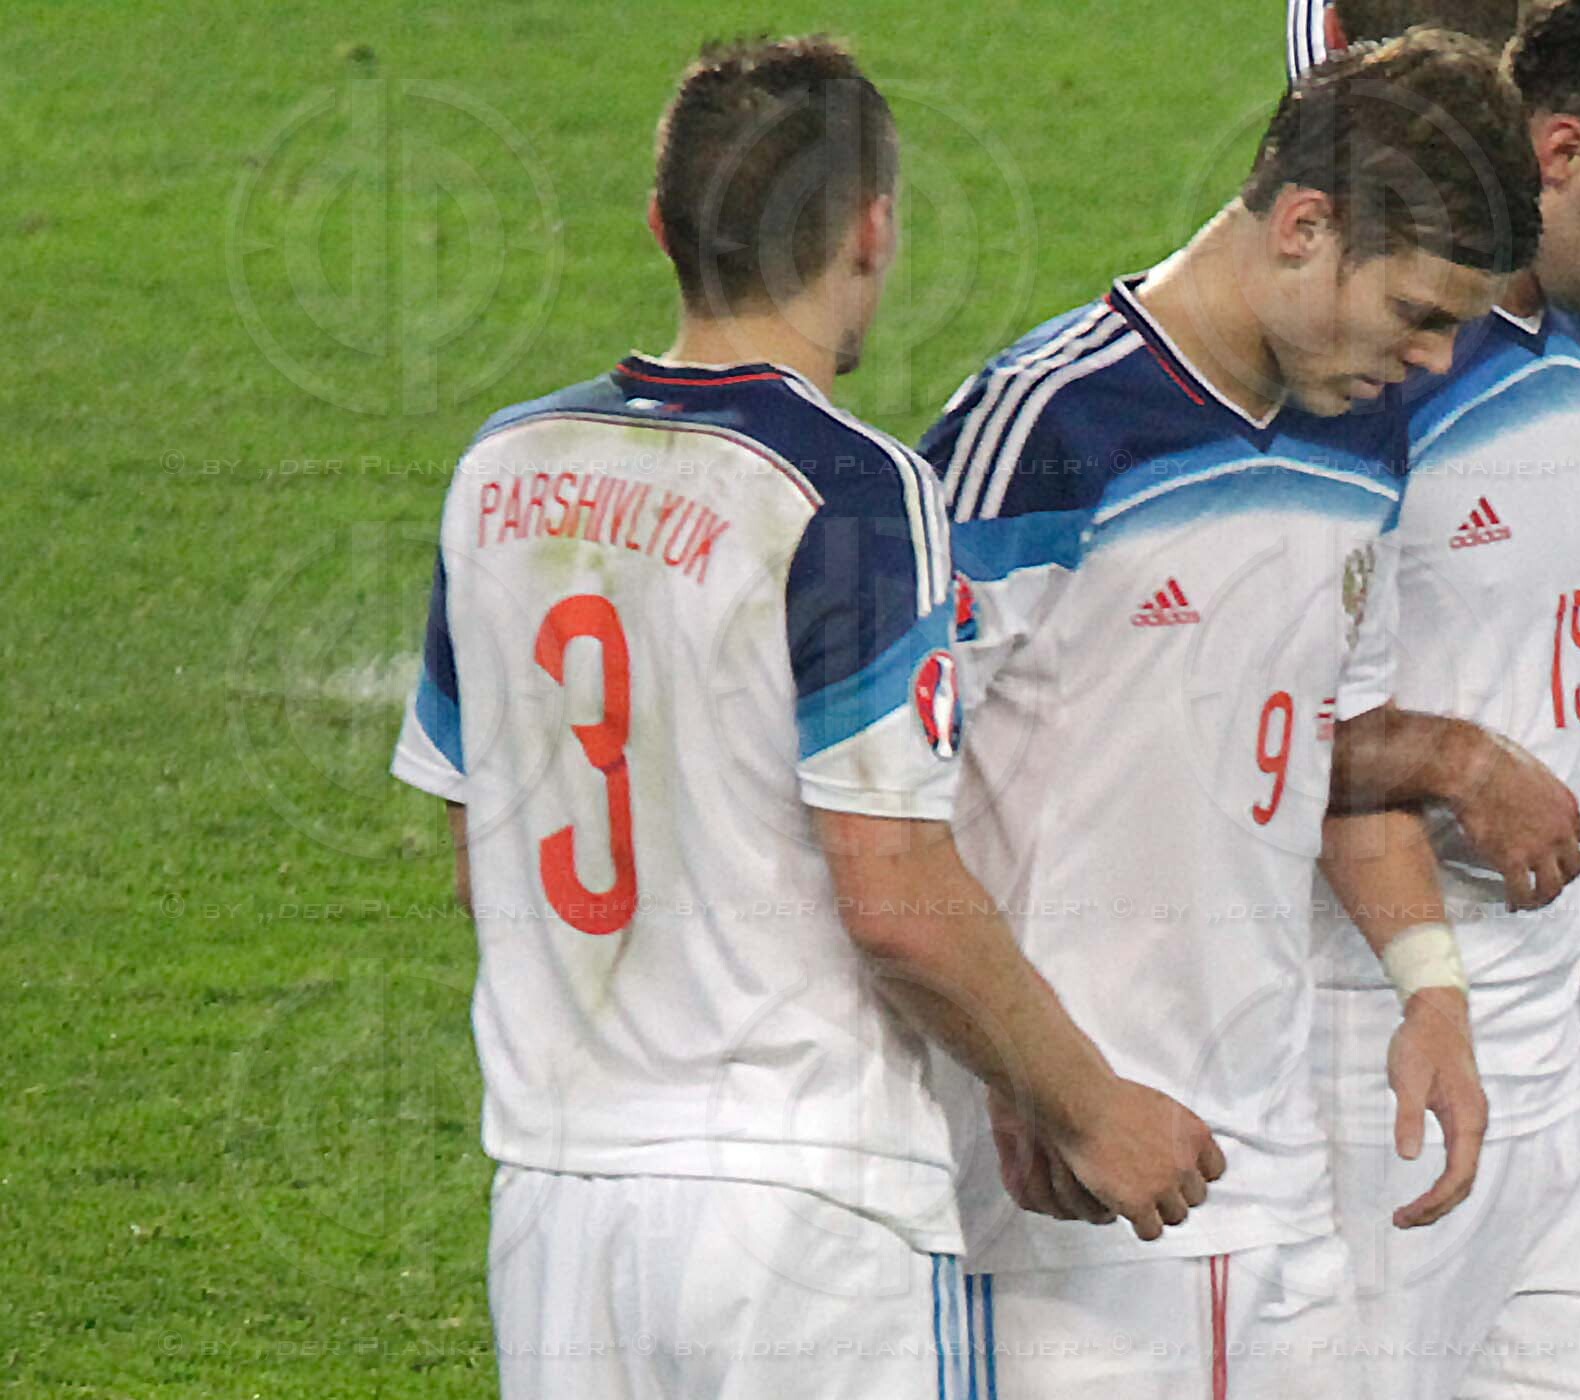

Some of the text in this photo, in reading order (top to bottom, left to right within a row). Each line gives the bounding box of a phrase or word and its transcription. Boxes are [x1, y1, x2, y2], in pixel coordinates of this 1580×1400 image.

[478, 472, 731, 584] PARSHIVLYUK
[1449, 526, 1512, 550] adidas
[1131, 609, 1201, 627] adidas
[535, 594, 637, 935] 3
[1253, 690, 1295, 826] 9
